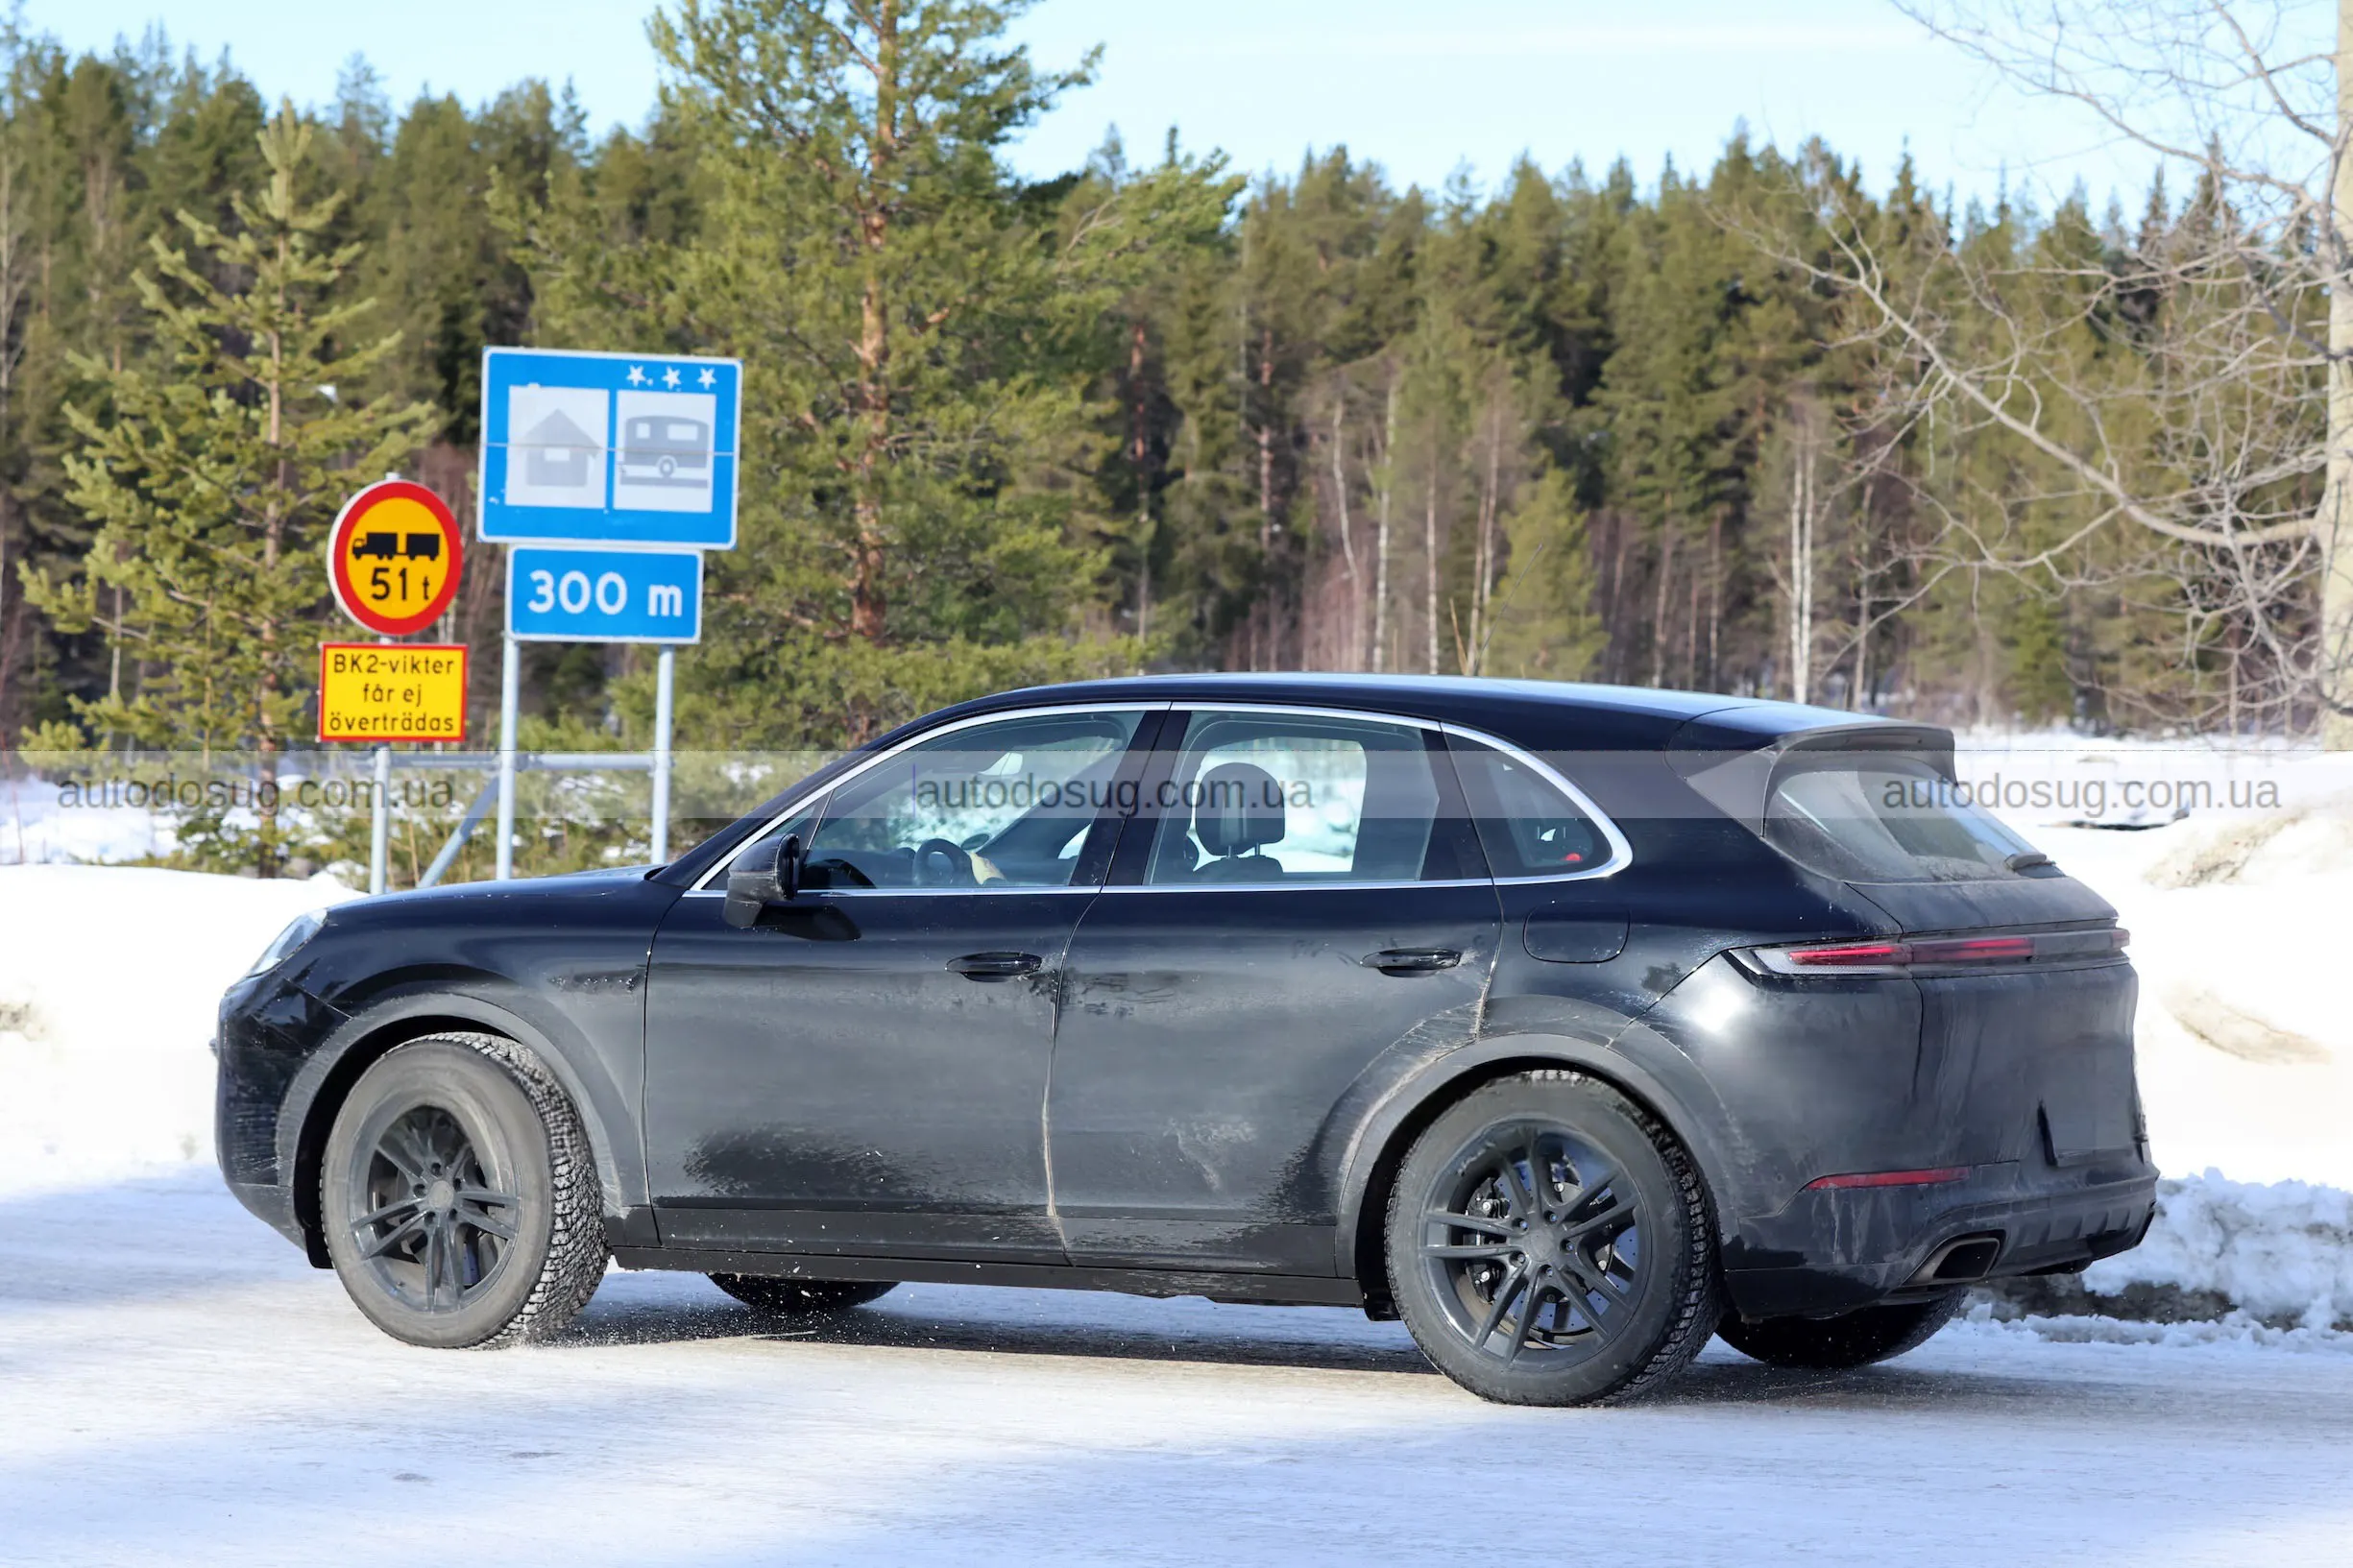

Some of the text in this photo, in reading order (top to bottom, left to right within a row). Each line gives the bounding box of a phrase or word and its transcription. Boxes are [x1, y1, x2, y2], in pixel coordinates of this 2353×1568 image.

[371, 567, 431, 602] 51 t
[527, 569, 683, 617] 300 m
[333, 653, 454, 674] BK2-vikter
[363, 683, 423, 707] får ej
[329, 711, 454, 732] överträdas
